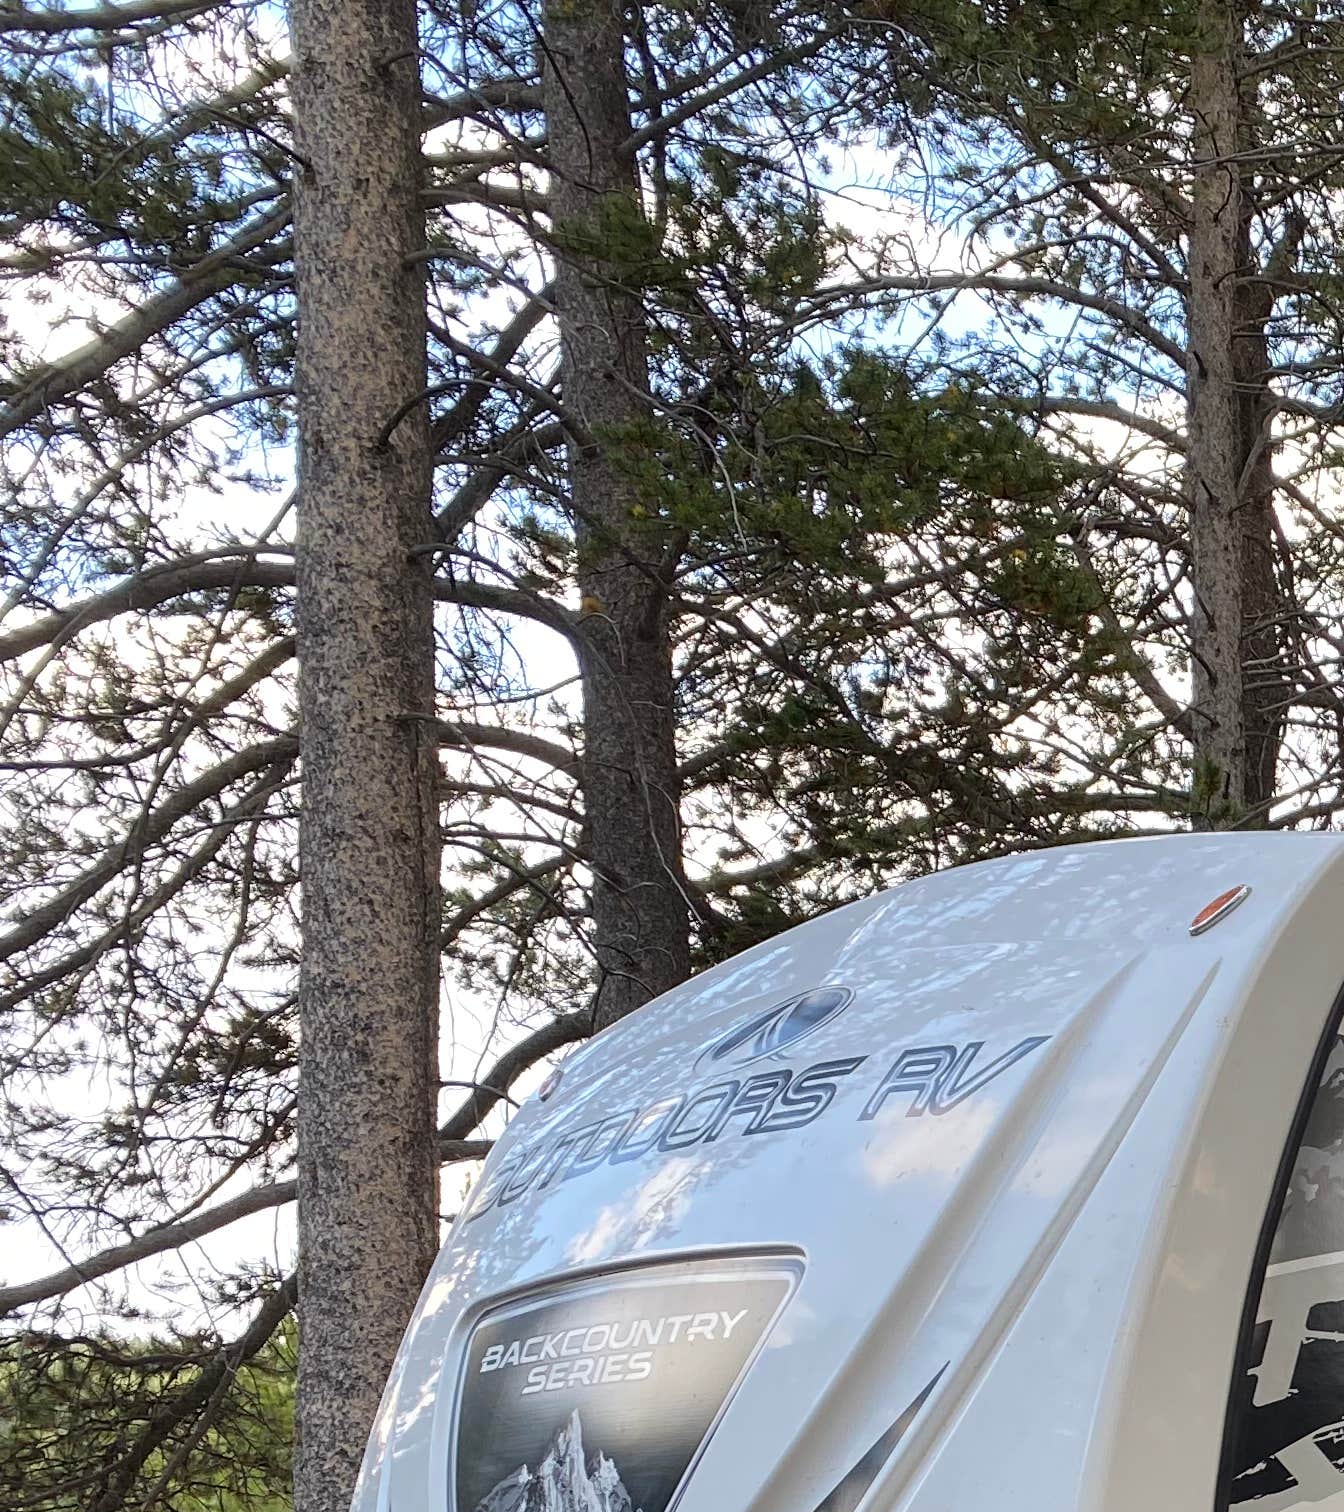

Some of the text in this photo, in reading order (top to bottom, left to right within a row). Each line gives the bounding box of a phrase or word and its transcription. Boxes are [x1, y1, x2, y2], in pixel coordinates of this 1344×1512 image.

[465, 1034, 1053, 1225] OUTDOORS RV
[479, 1308, 750, 1374] BACKCOUNTRY
[521, 1350, 654, 1396] SERIES
